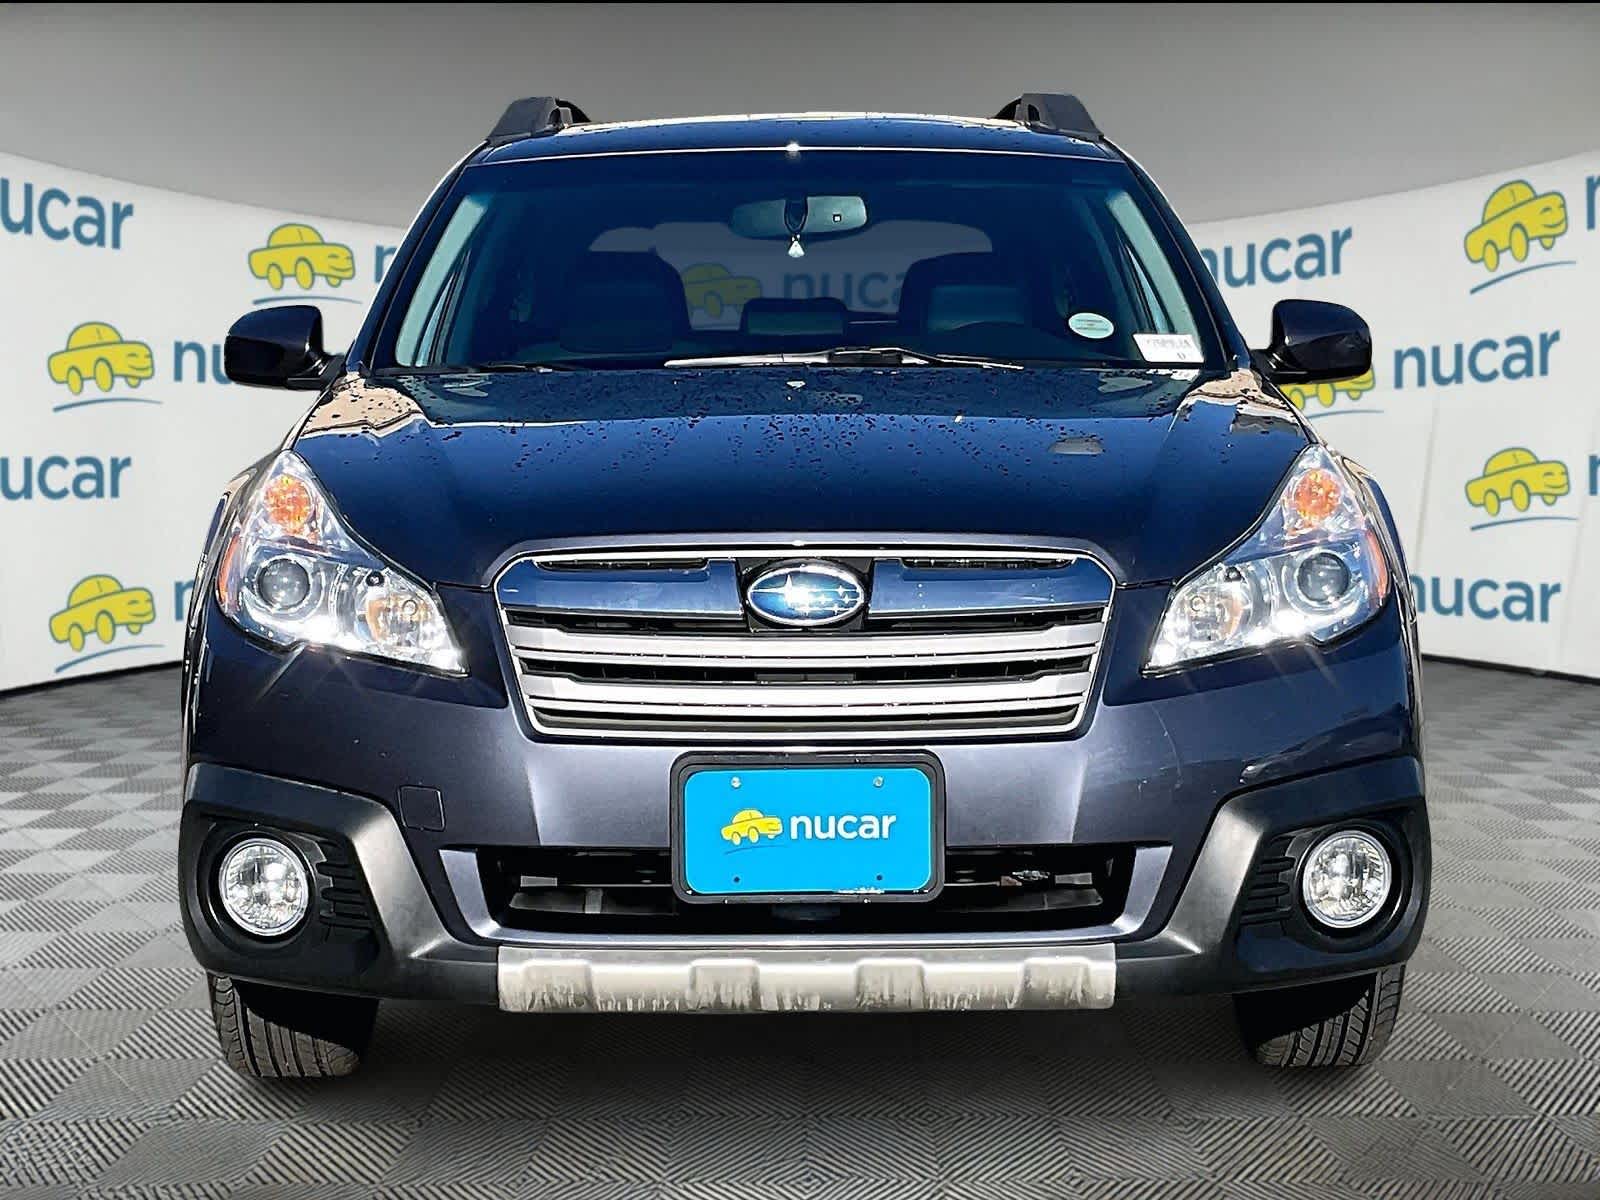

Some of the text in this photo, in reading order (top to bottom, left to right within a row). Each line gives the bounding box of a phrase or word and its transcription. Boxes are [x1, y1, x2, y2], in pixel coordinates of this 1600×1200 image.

[0, 177, 134, 249] ucar
[783, 271, 906, 308] nuc
[1394, 330, 1560, 389] nucar
[0, 455, 131, 500] ucar
[790, 814, 896, 839] nucar
